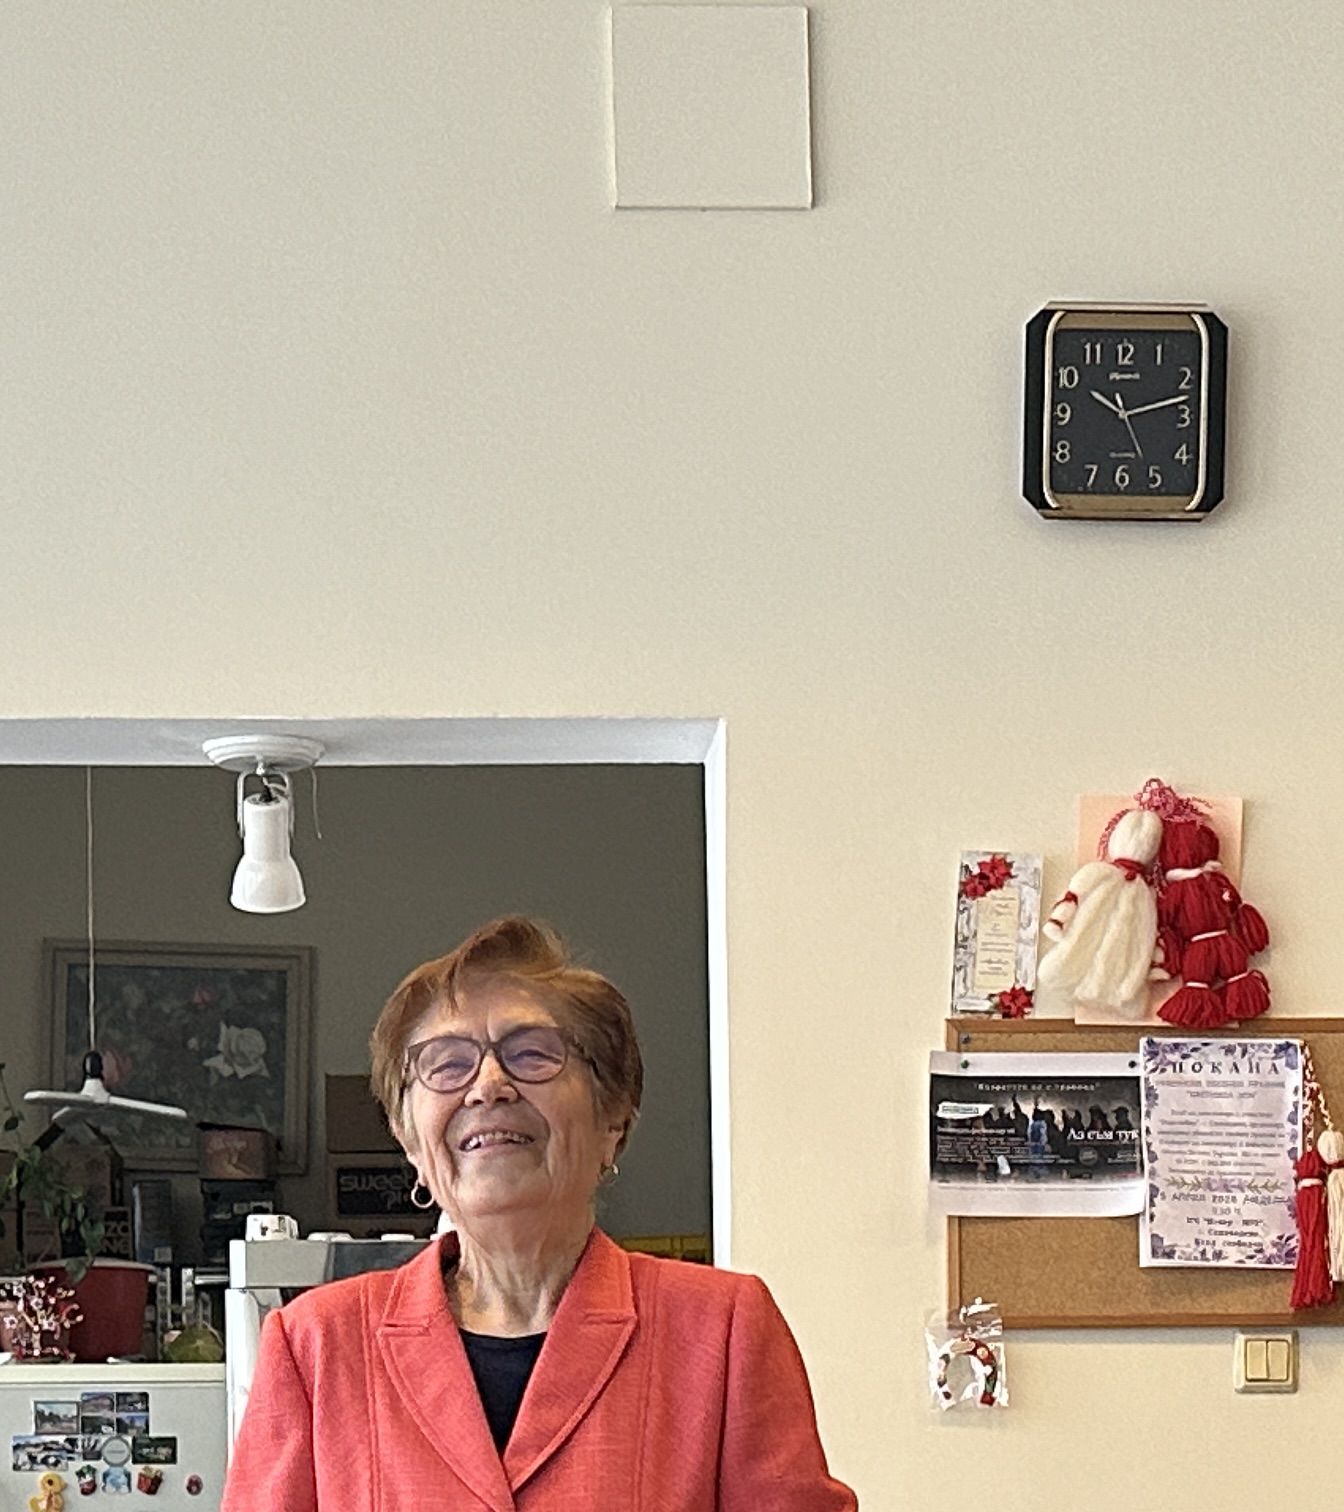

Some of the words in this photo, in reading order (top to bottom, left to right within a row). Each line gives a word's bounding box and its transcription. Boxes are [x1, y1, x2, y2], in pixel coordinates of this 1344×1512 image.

[1083, 342, 1102, 365] 11
[1116, 342, 1135, 366] 12
[1154, 343, 1163, 366] 1
[1058, 366, 1079, 388] 10
[1178, 367, 1193, 390] 2
[1055, 402, 1071, 426] 9
[1176, 405, 1192, 428] 3
[1054, 440, 1071, 463] 8
[1174, 443, 1193, 466] 4
[1083, 464, 1098, 487] 7
[1114, 464, 1130, 487] 6
[1148, 466, 1163, 488] 5
[1171, 1060, 1280, 1075] ПОКАНА
[1067, 1127, 1085, 1140] Аз
[1087, 1131, 1113, 1140] съм
[1116, 1130, 1139, 1144] тук
